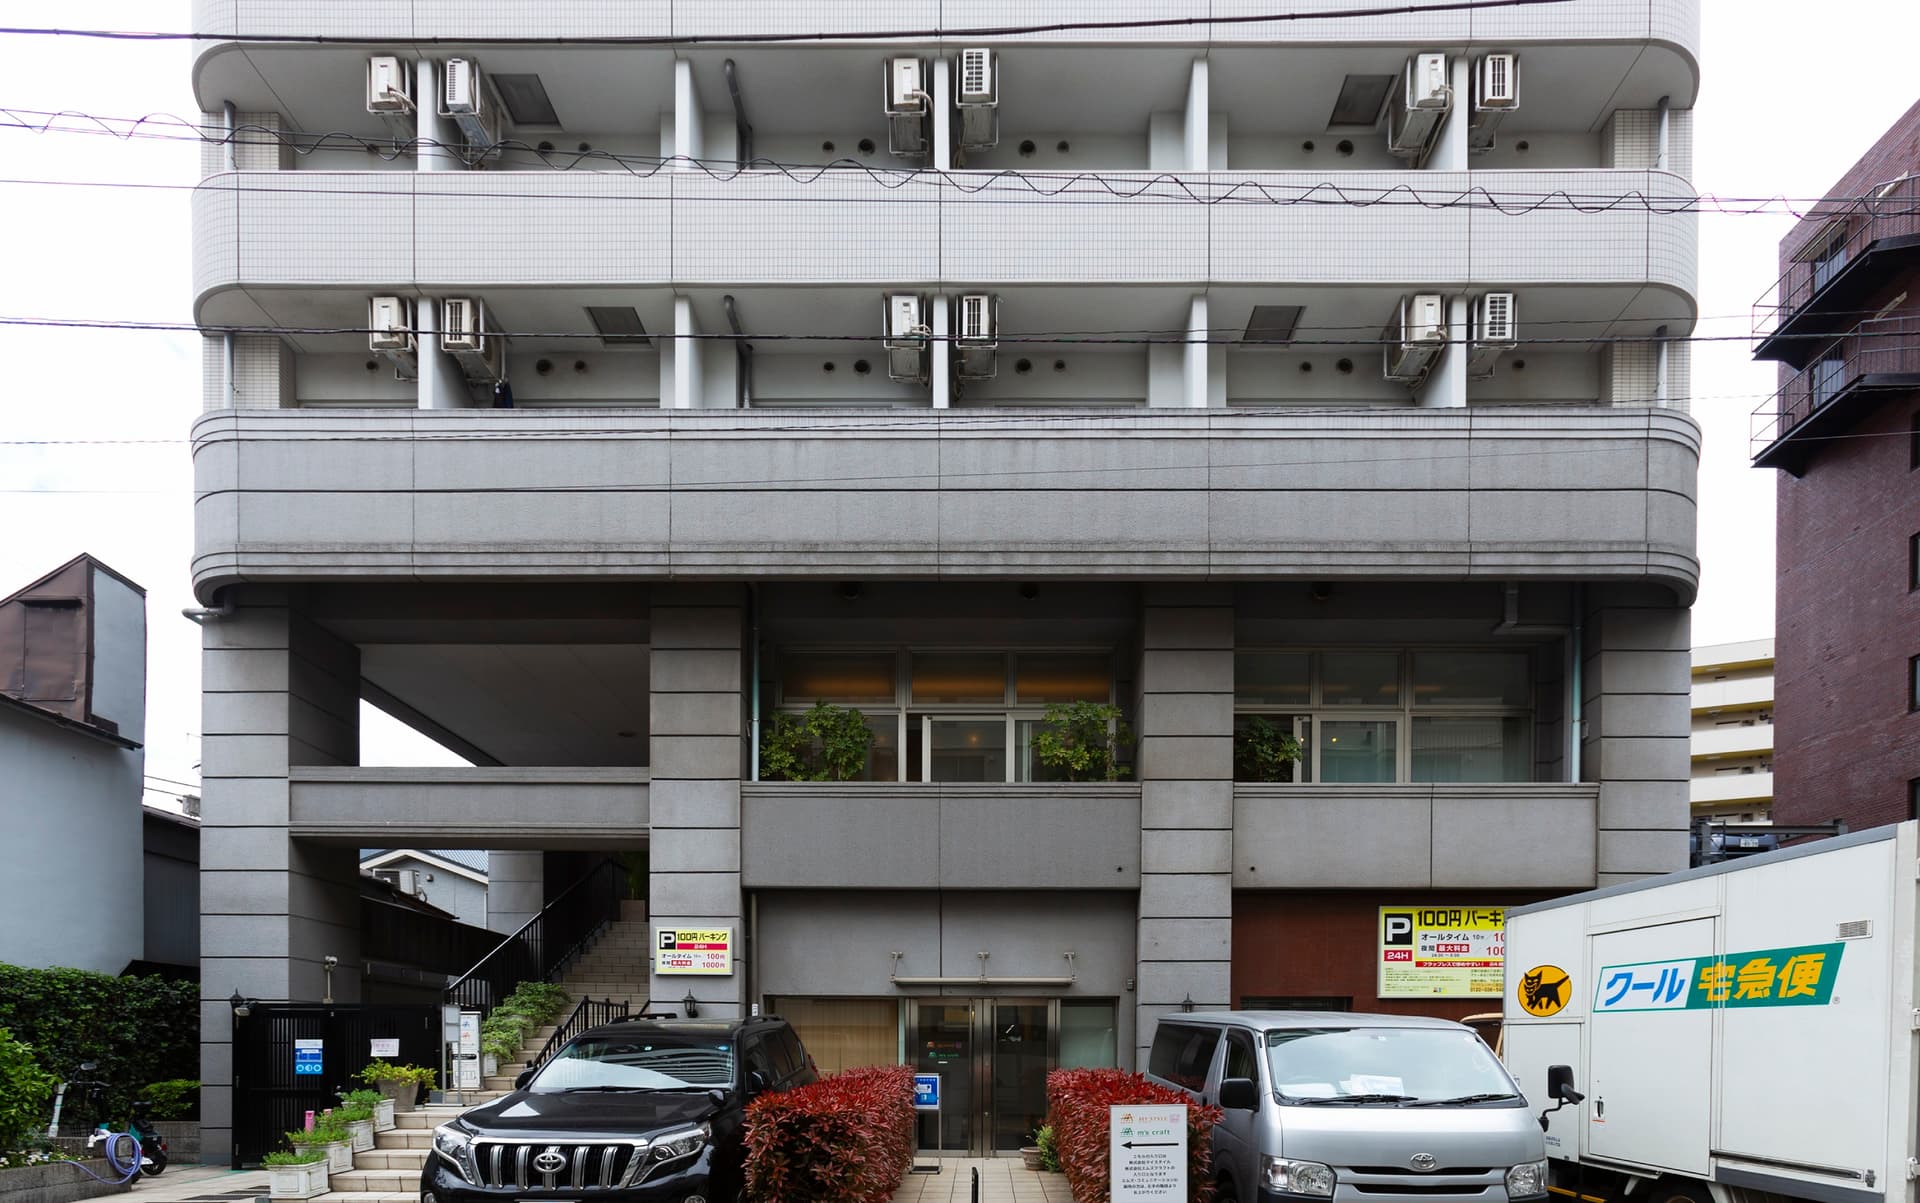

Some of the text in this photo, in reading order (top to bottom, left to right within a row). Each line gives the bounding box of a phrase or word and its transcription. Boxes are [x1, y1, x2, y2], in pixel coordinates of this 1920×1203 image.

[1417, 910, 1504, 927] 100円パーキ
[1386, 917, 1411, 942] P
[660, 933, 676, 948] P
[677, 932, 728, 941] 100円パーキング
[1421, 933, 1470, 941] オールタイム
[1387, 952, 1409, 960] 24H
